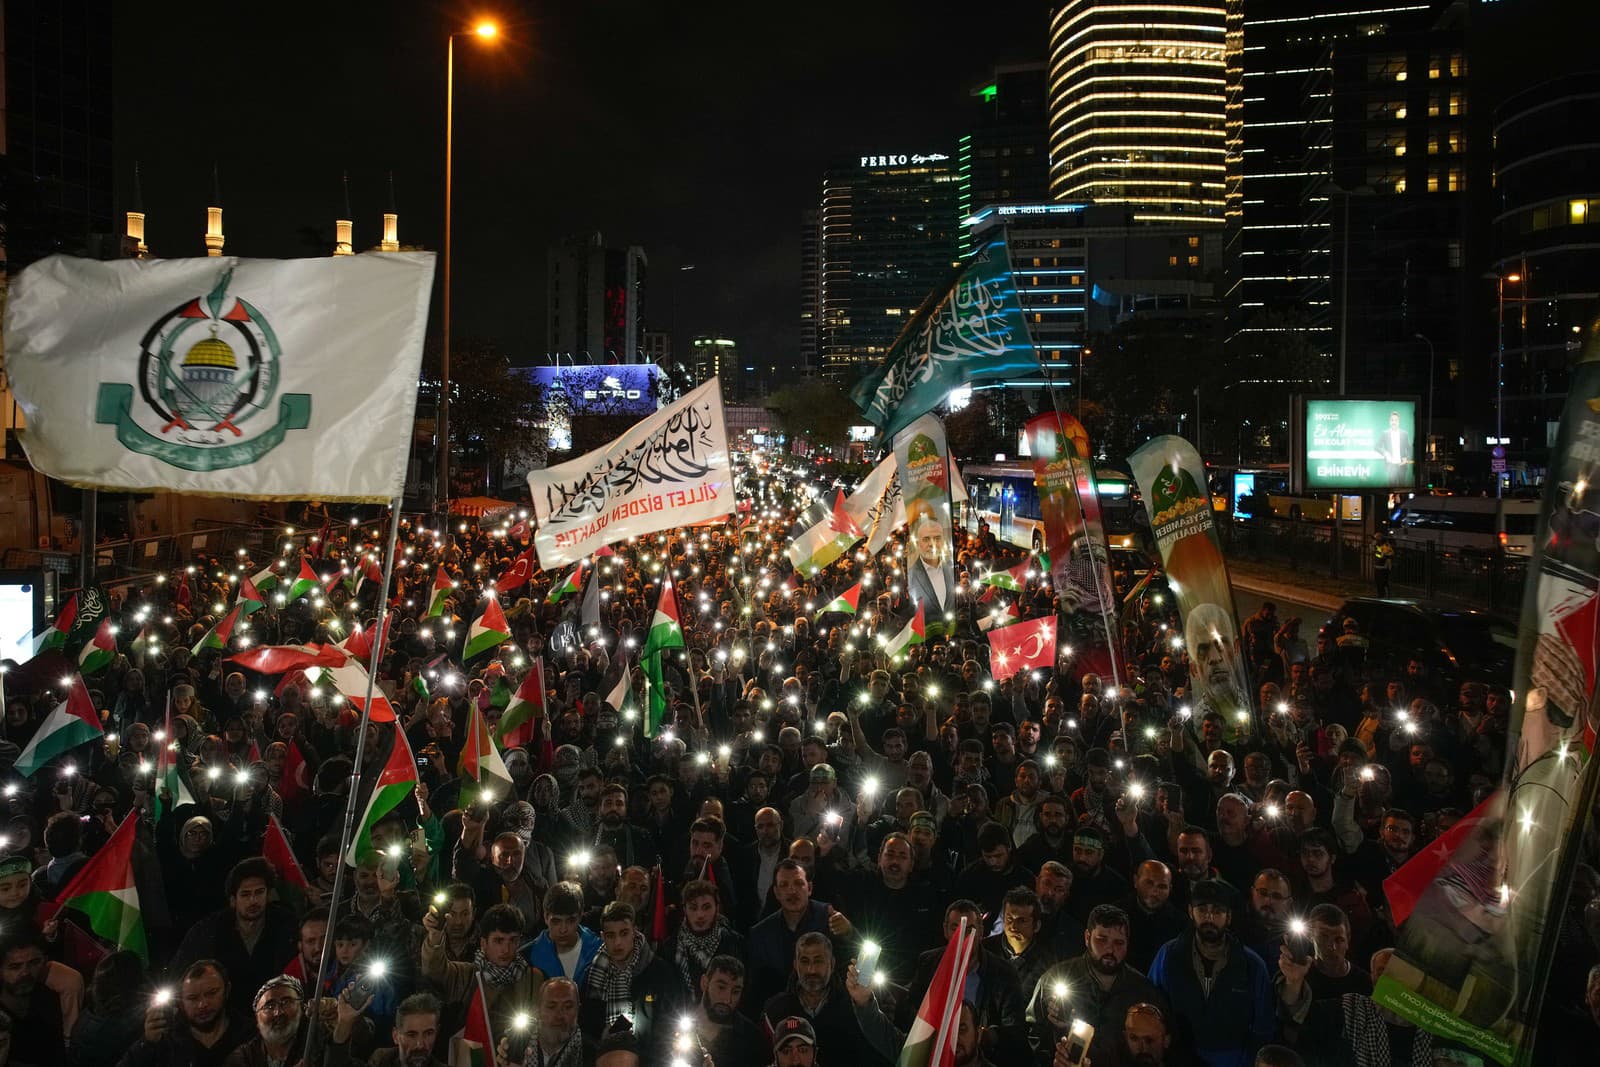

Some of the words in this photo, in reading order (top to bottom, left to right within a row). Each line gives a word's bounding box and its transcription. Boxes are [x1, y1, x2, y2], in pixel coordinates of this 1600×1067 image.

[861, 155, 907, 167] FERKO
[1021, 206, 1046, 214] HOTELS
[1317, 464, 1370, 477] EMİNEVİM
